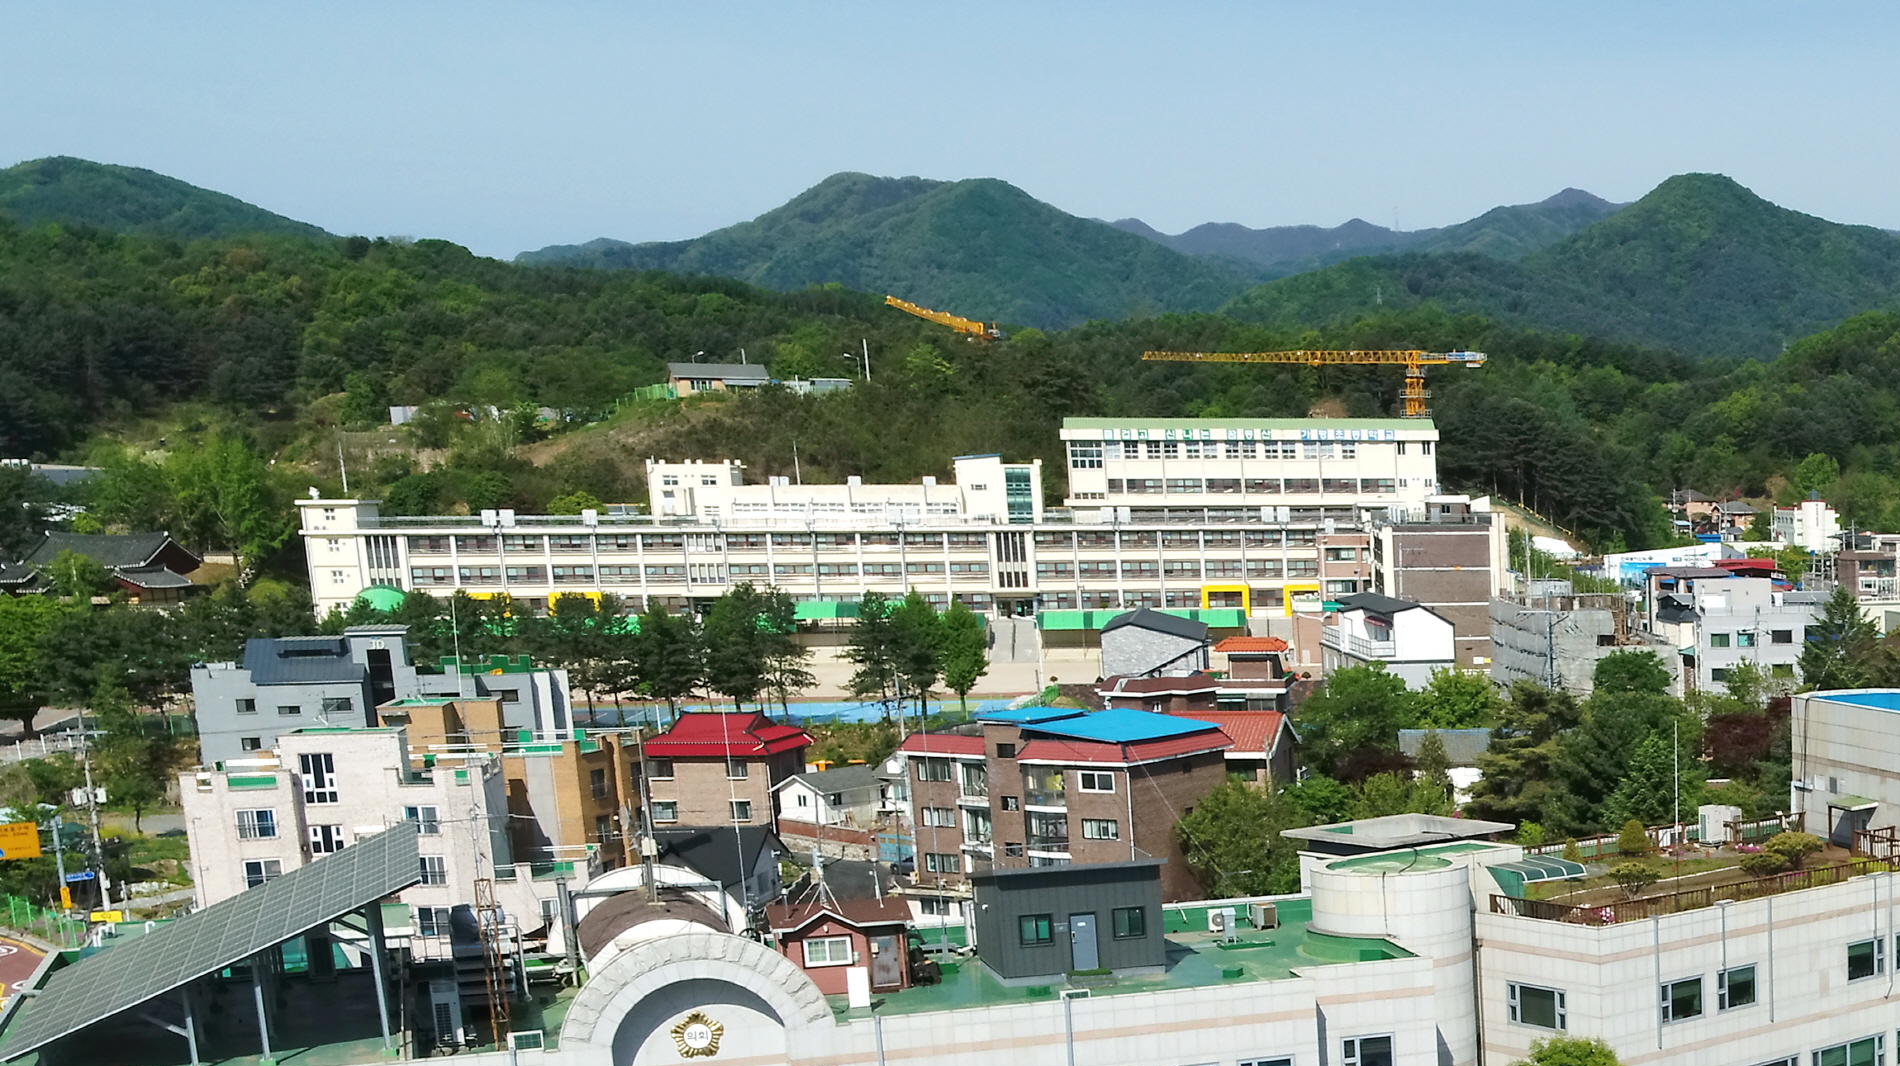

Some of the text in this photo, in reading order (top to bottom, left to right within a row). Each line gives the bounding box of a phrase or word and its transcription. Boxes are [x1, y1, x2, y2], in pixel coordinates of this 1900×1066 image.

[1165, 428, 1211, 440] 신나는
[1226, 428, 1272, 440] 꿈동산
[1301, 428, 1395, 440] 가평초등학교
[686, 1030, 709, 1042] 의회
